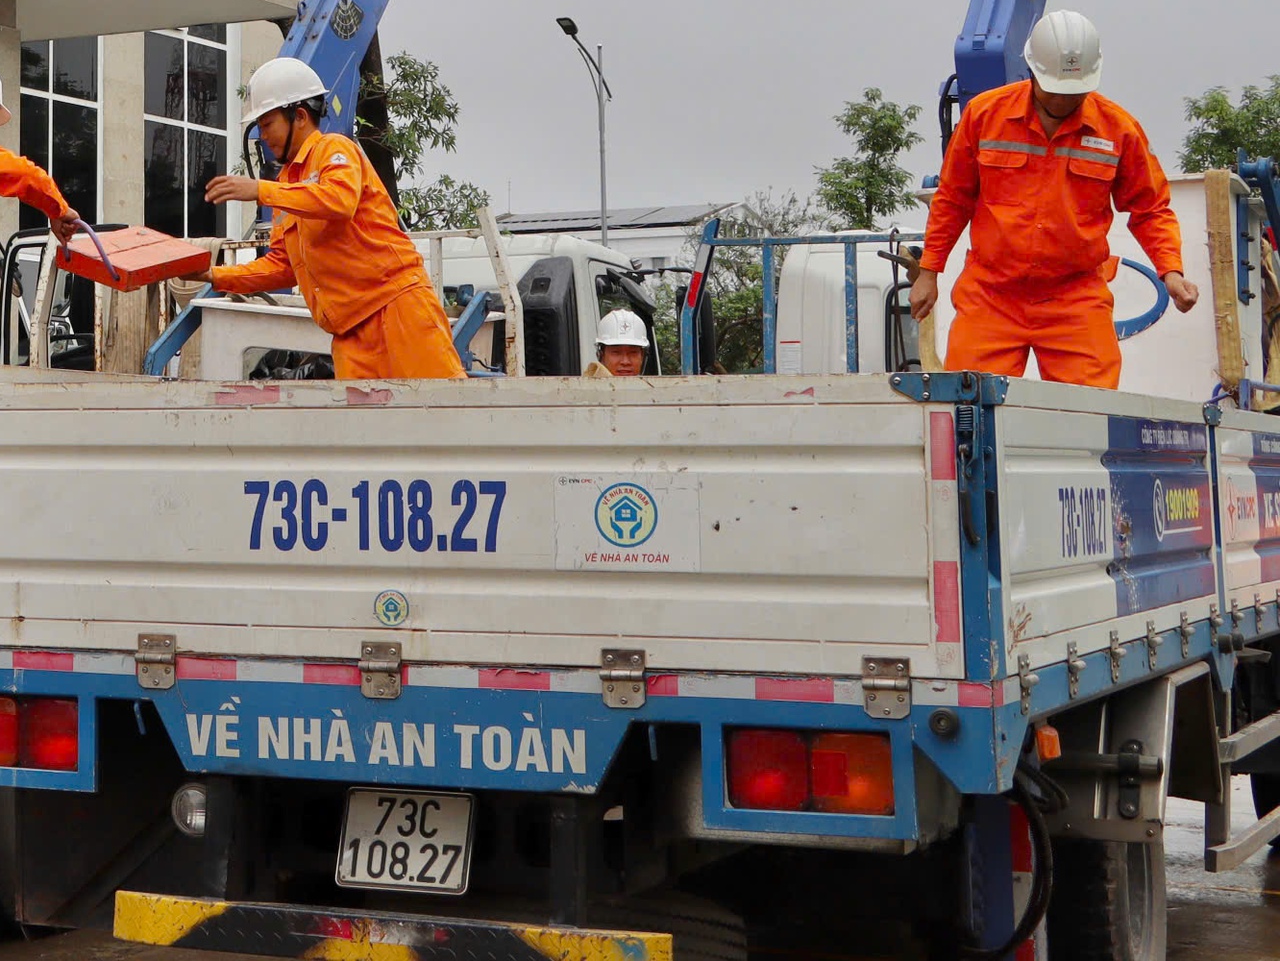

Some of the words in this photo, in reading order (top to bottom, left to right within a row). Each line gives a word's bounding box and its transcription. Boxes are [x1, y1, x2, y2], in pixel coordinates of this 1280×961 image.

[244, 479, 508, 553] 73C-108.27
[1058, 486, 1107, 558] 73C-108.27
[1165, 488, 1199, 521] 19001909
[623, 553, 639, 563] AN
[185, 696, 241, 758] VỀ
[257, 708, 356, 763] NHÀ
[367, 721, 436, 767] AN
[453, 712, 587, 774] TOÀN
[373, 796, 442, 838] 73C
[346, 838, 463, 885] 108.27
